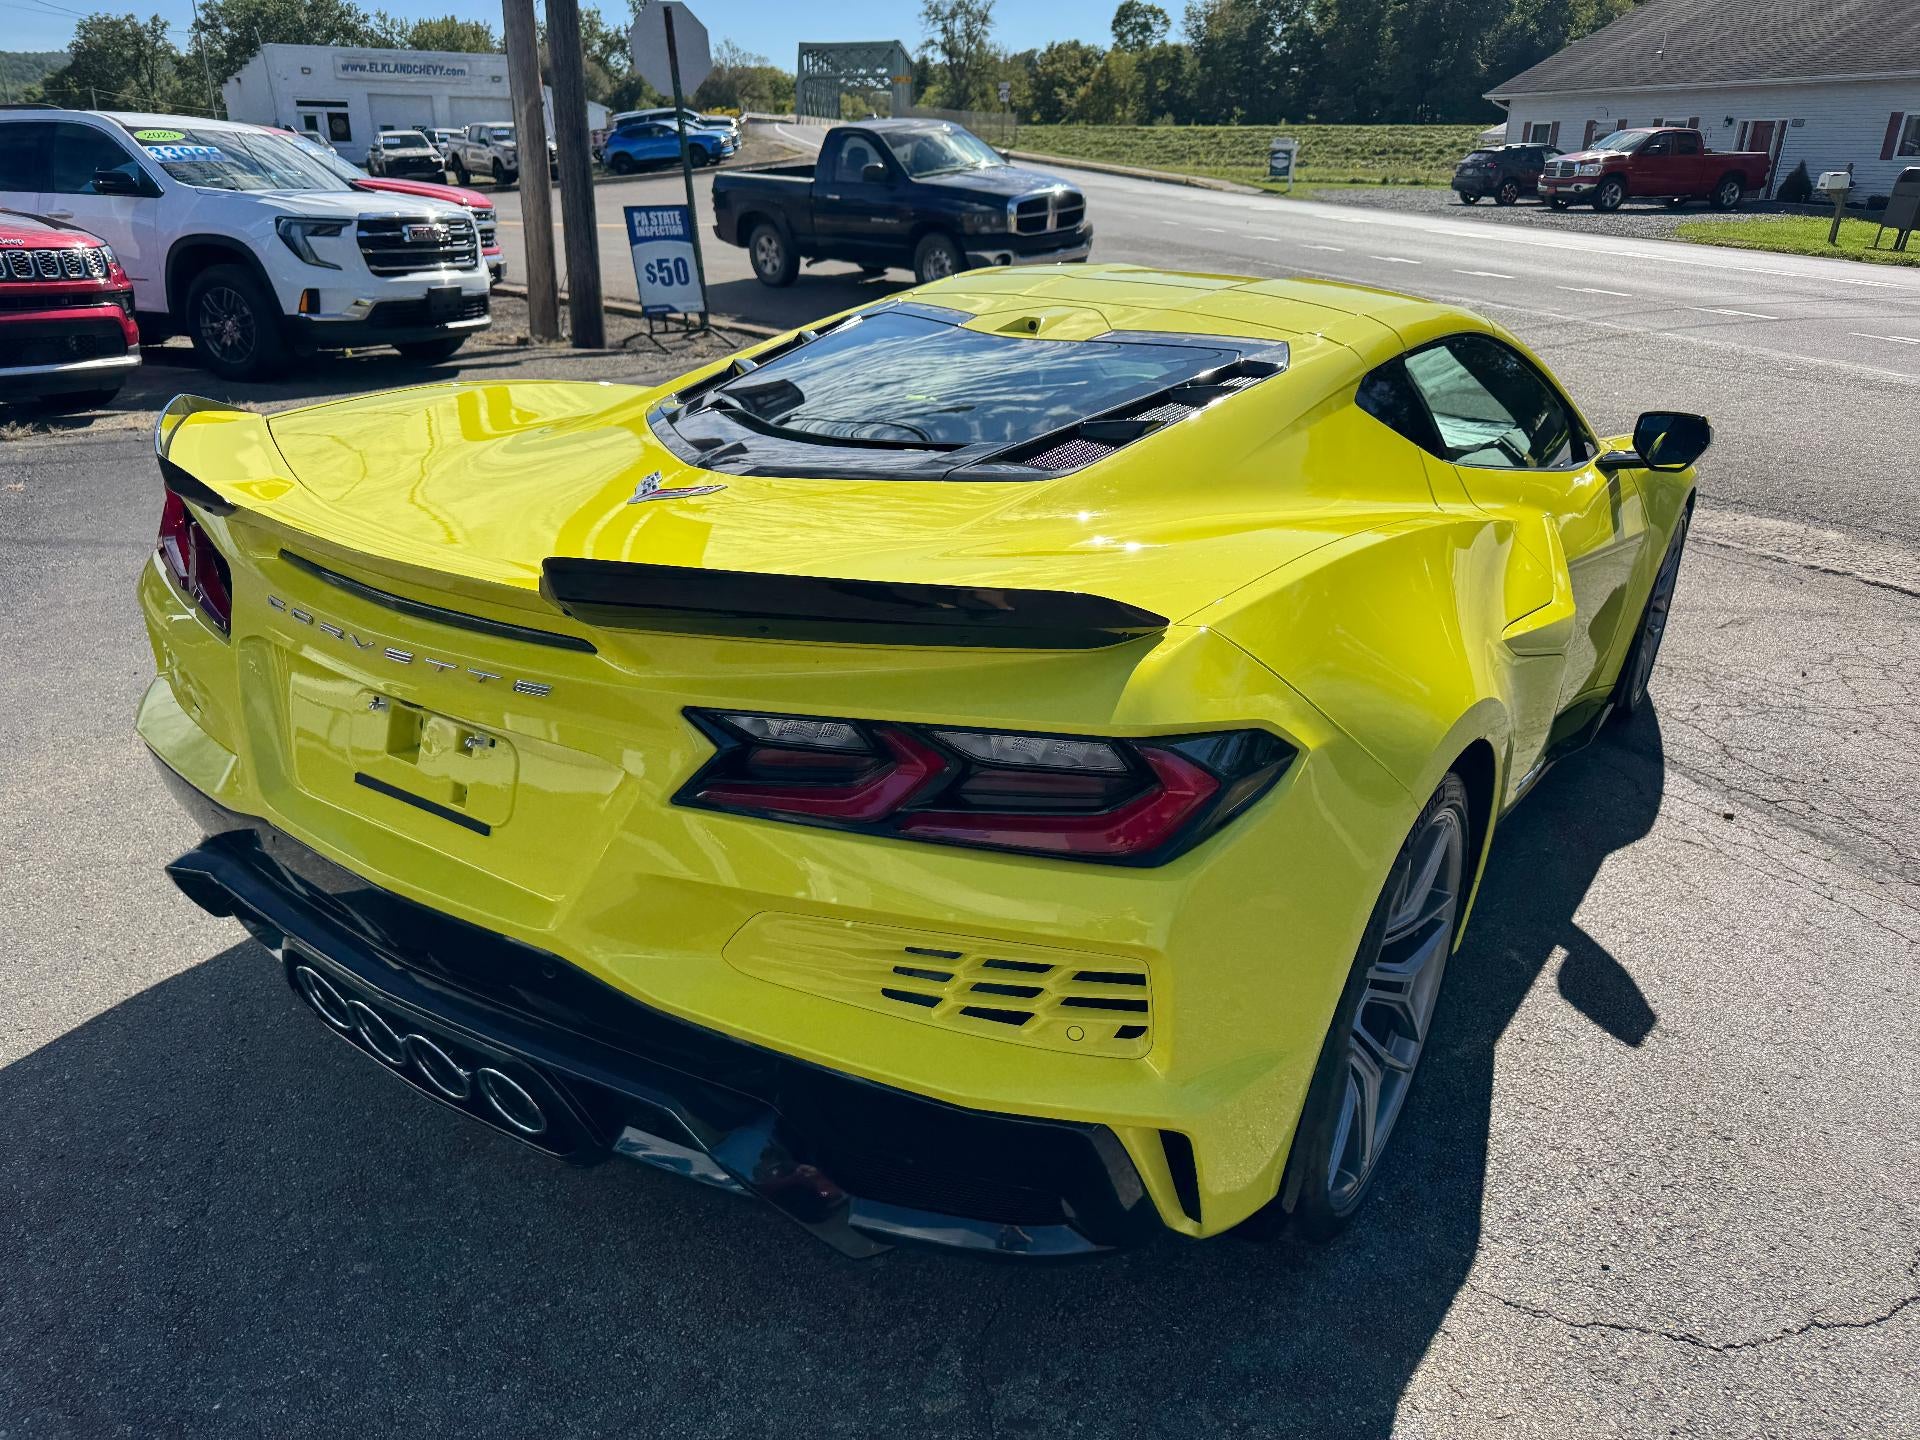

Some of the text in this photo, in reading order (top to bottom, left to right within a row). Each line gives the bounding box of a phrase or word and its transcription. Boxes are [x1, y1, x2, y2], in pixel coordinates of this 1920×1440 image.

[341, 62, 466, 76] www.ELKLANDCHEVY.com
[147, 146, 225, 161] 33995
[633, 211, 682, 226] PA STATE
[636, 225, 683, 237] INSPECTION
[644, 256, 690, 287] $50
[267, 594, 553, 697] CORVETTE
